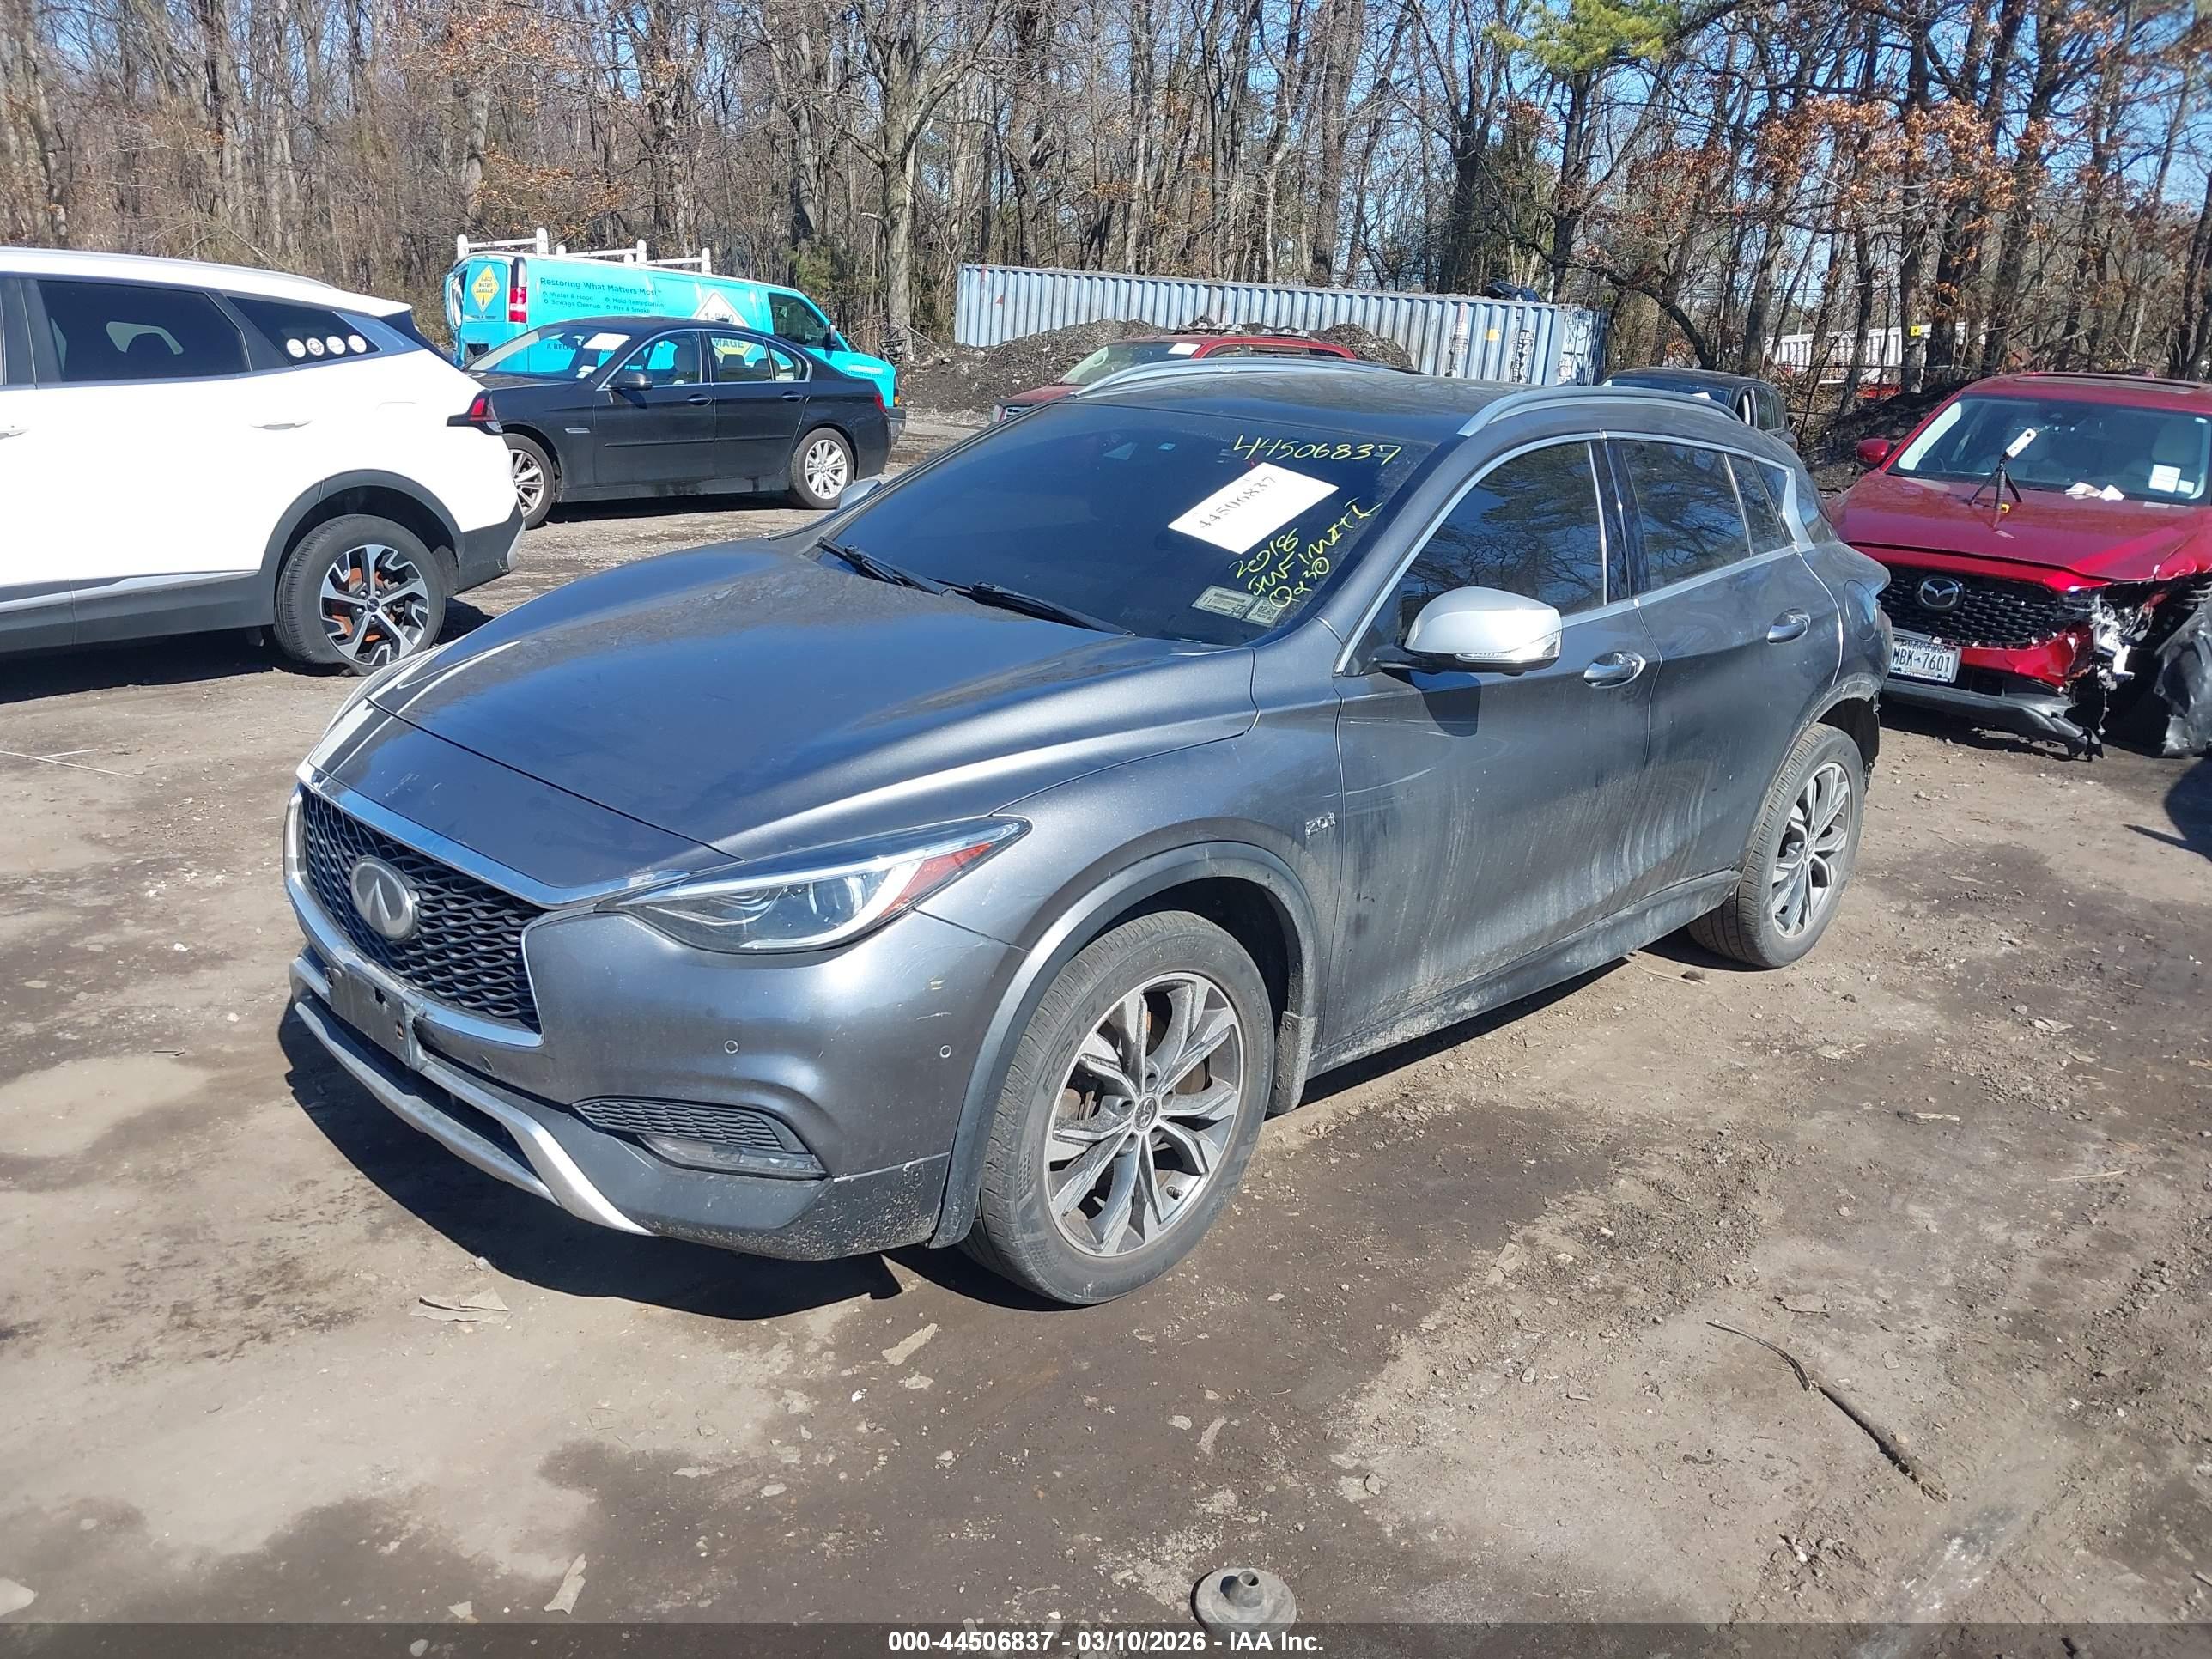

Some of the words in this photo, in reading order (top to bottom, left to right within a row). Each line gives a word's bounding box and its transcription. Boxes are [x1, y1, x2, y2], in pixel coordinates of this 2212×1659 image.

[540, 276, 580, 289] Restoring
[584, 281, 605, 291] What
[607, 284, 638, 295] Matters
[714, 338, 744, 349] MAGE
[1233, 434, 1401, 466] 44506837
[1199, 476, 1277, 528] 44506837
